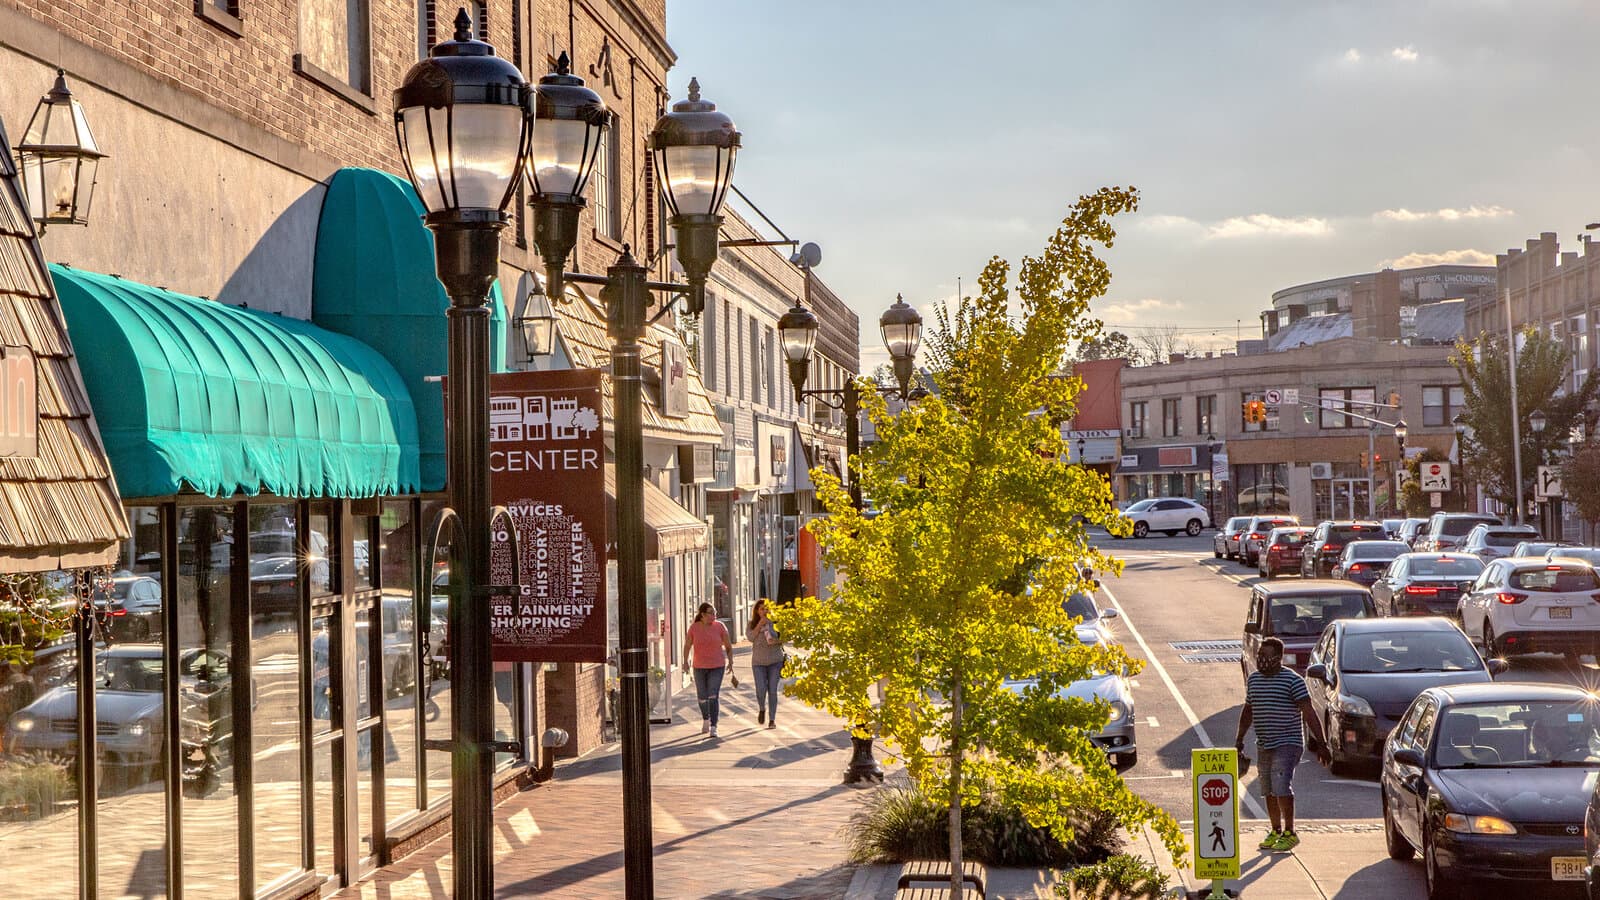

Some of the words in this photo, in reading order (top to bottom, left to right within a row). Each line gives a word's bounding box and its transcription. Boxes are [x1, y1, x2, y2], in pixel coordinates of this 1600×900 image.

[1066, 430, 1110, 438] UNION
[490, 449, 599, 472] CENTER
[508, 505, 563, 516] RVICES
[528, 530, 537, 568] SERVICES
[537, 527, 548, 597] HISTORY
[572, 522, 583, 597] THEATER
[531, 597, 594, 605] ENTERTAINMENT
[491, 604, 594, 615] ERAINMENT
[491, 616, 571, 628] SHOPPING
[1200, 753, 1230, 762] STATE
[1204, 764, 1225, 772] LAW
[1202, 787, 1229, 799] STOP
